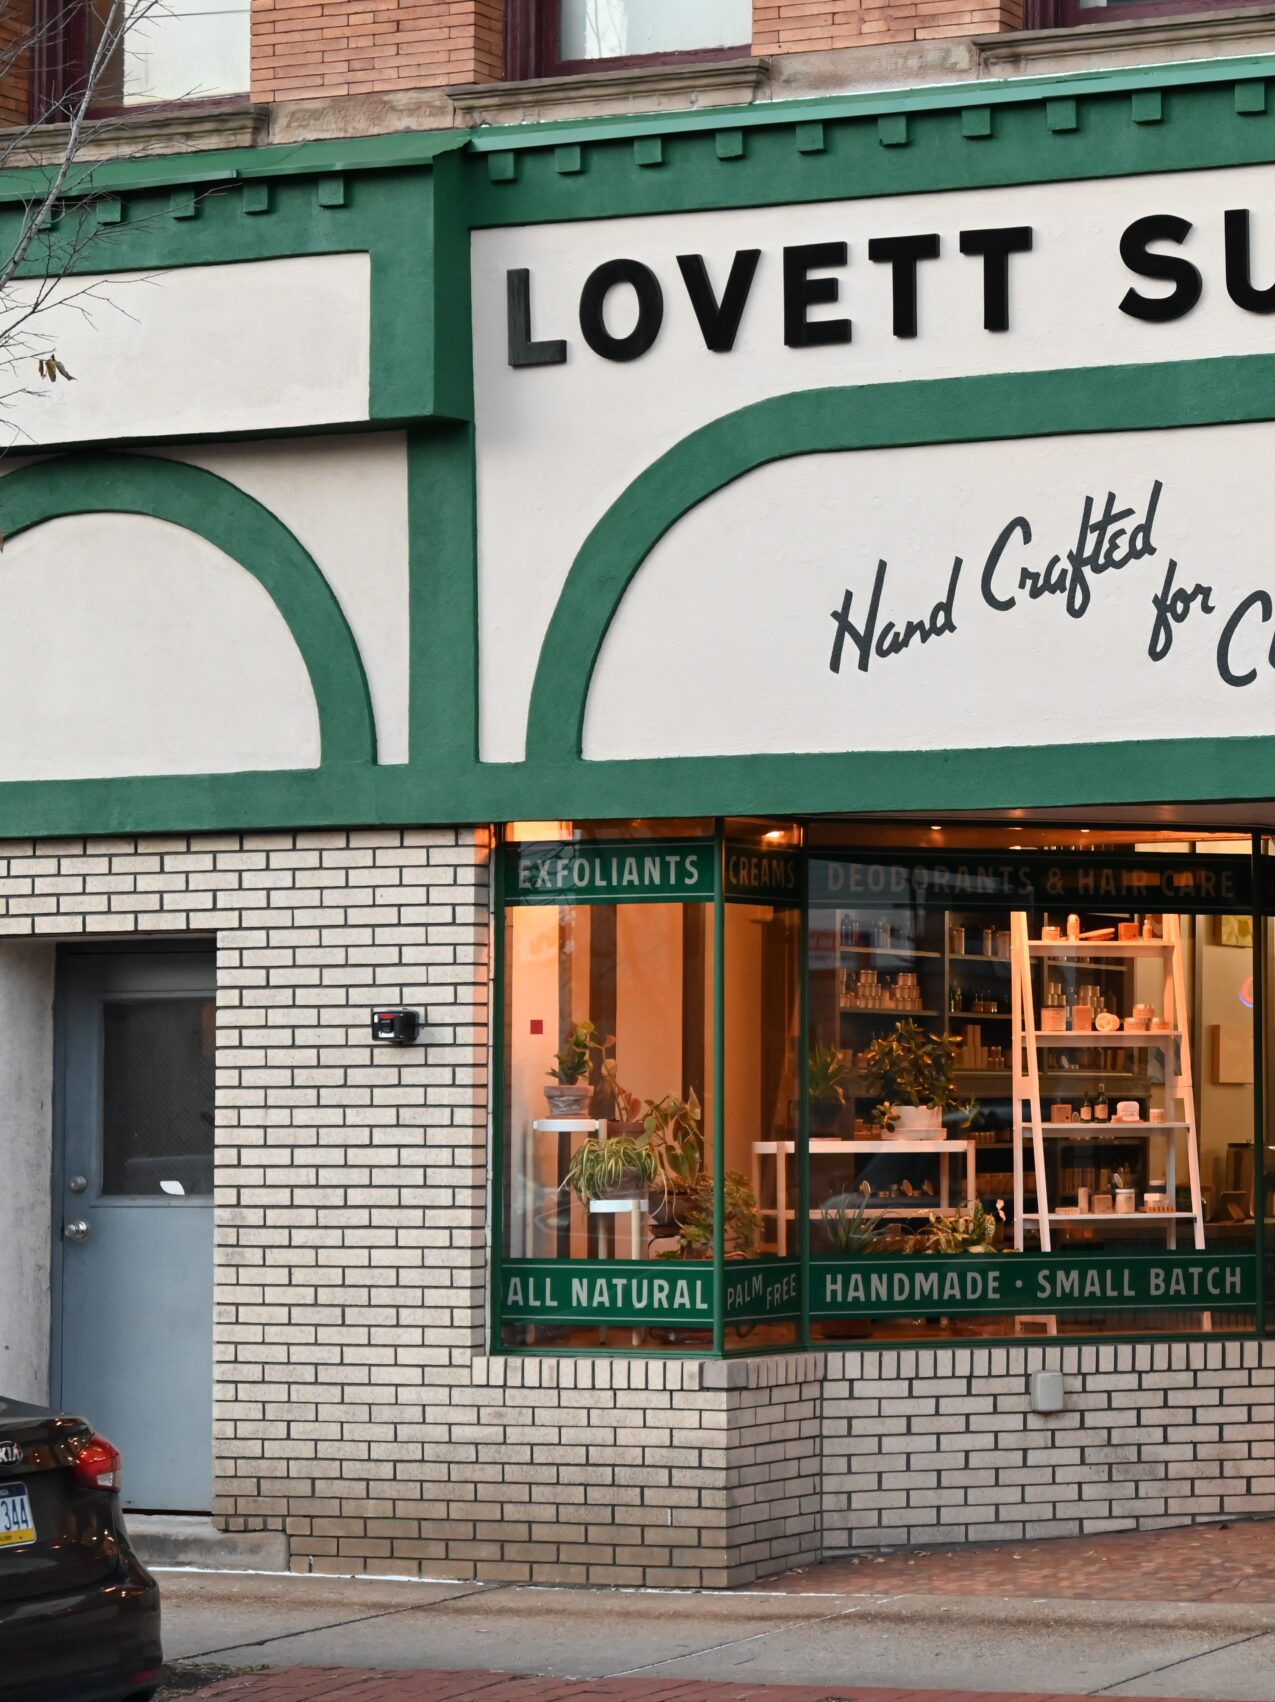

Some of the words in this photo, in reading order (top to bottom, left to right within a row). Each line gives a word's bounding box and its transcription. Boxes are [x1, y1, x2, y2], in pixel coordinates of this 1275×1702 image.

[506, 225, 1034, 370] LOVETT
[829, 556, 964, 674] Hand
[980, 479, 1163, 619] Crafted
[1147, 558, 1216, 662] for
[518, 854, 700, 889] EXFOLIANTS
[728, 855, 795, 889] CREAMS
[826, 863, 1032, 896] DEODORANTS
[1046, 867, 1065, 896] &
[1078, 868, 1148, 897] HAIR
[1160, 869, 1235, 899] CARE
[506, 1276, 558, 1307] ALL
[571, 1277, 709, 1309] NATURAL
[726, 1273, 763, 1311] PALM
[766, 1272, 797, 1310] FREE
[825, 1271, 1000, 1303] HANDMADE
[1036, 1268, 1136, 1299] SMALL
[1149, 1266, 1242, 1296] BATCH
